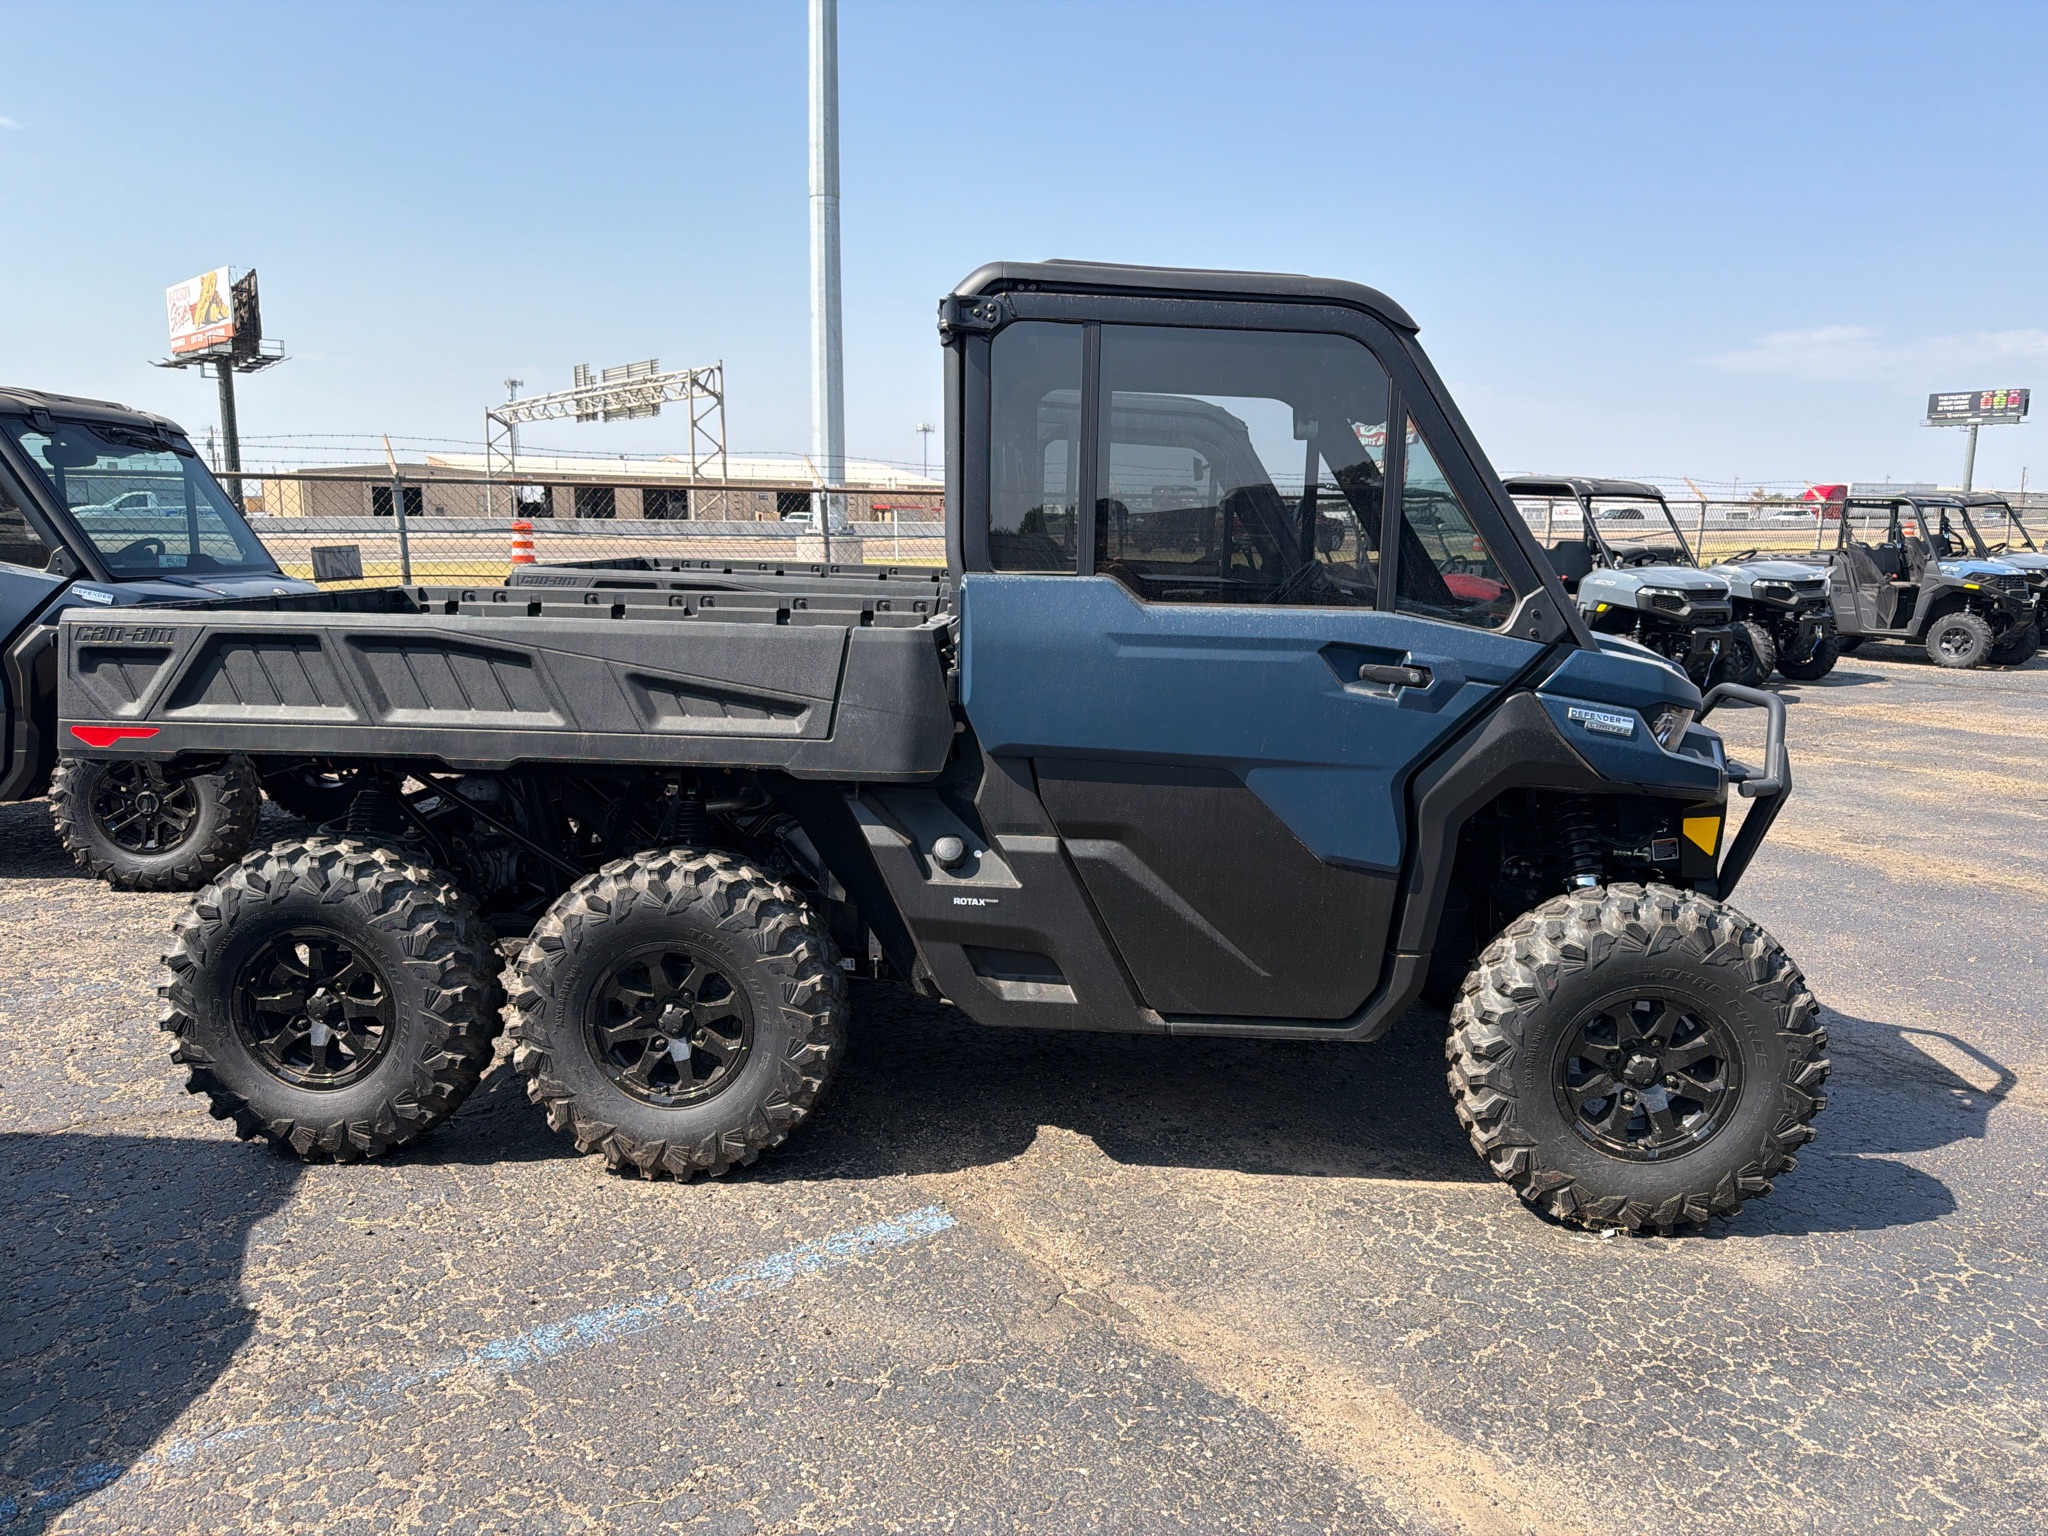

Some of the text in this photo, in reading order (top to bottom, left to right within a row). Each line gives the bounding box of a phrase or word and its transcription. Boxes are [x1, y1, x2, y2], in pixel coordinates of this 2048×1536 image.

[520, 575, 578, 586] can-am
[73, 588, 113, 600] DEFENDER
[75, 626, 178, 645] can-am
[1571, 710, 1621, 723] DEFENDER
[953, 897, 985, 906] ROTAX
